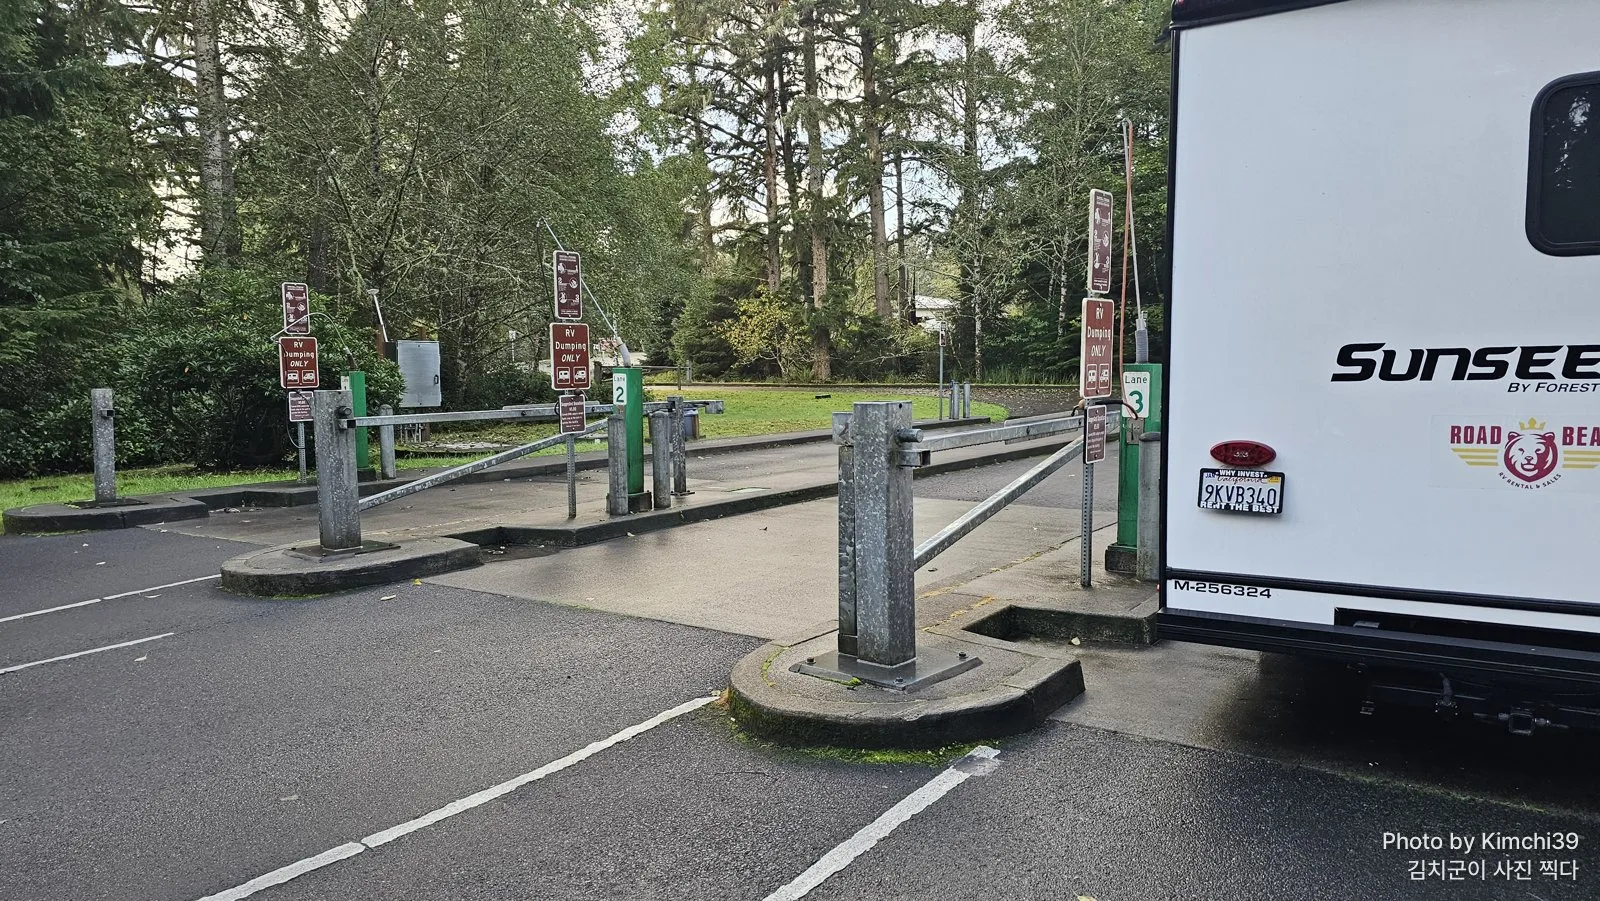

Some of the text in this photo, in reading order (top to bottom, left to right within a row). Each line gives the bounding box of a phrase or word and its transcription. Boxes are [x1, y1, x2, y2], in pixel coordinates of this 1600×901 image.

[1095, 307, 1104, 320] RV
[565, 329, 575, 337] RV
[1087, 326, 1112, 342] Dumping
[555, 341, 587, 351] Dumping
[1090, 344, 1107, 357] ONLY
[561, 354, 581, 362] ONLY
[1124, 375, 1148, 384] Lane
[1507, 382, 1600, 393] BY FOREST
[615, 386, 625, 403] 2
[1128, 390, 1144, 414] 3
[1450, 425, 1600, 446] ROAD BEA
[1219, 469, 1265, 478] WHY INVEST
[1498, 471, 1507, 480] RV
[1506, 479, 1534, 490] RENTAL
[1542, 473, 1562, 487] SALES
[1204, 484, 1277, 507] 9KVB340
[1200, 501, 1280, 513] RENT THE BEST
[1174, 580, 1272, 599] M-256324
